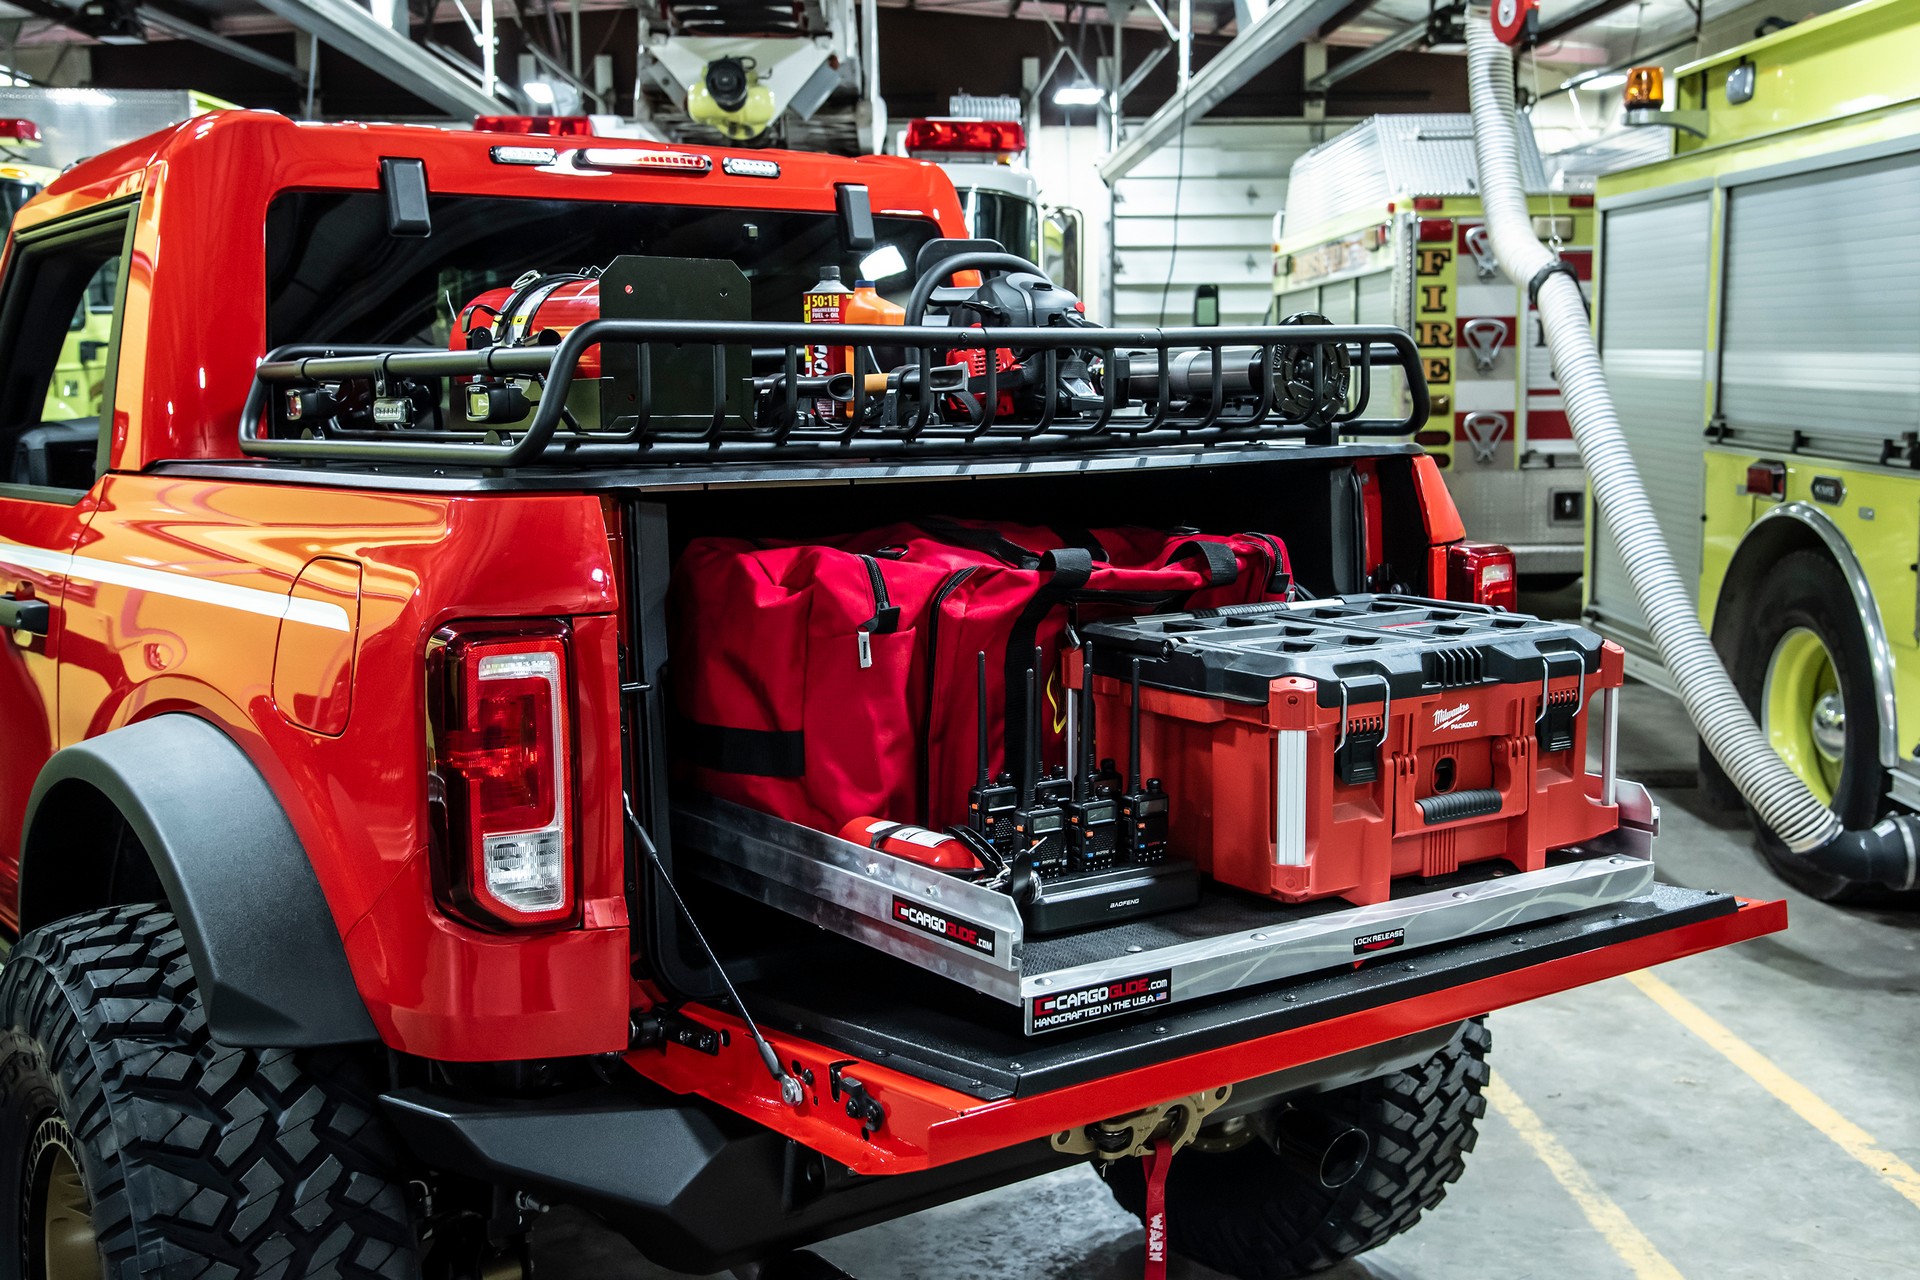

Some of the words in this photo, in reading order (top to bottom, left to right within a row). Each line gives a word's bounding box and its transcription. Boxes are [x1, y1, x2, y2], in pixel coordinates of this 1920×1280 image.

[812, 295, 832, 307] 50:1
[1416, 249, 1453, 383] FIRE
[1432, 703, 1470, 726] Milwaukee
[1451, 721, 1478, 730] PACKOUT
[1034, 1005, 1101, 1028] HANDCRAFTED
[1103, 1004, 1111, 1013] IN
[1113, 999, 1131, 1010] THE
[1149, 1212, 1163, 1262] WARN
